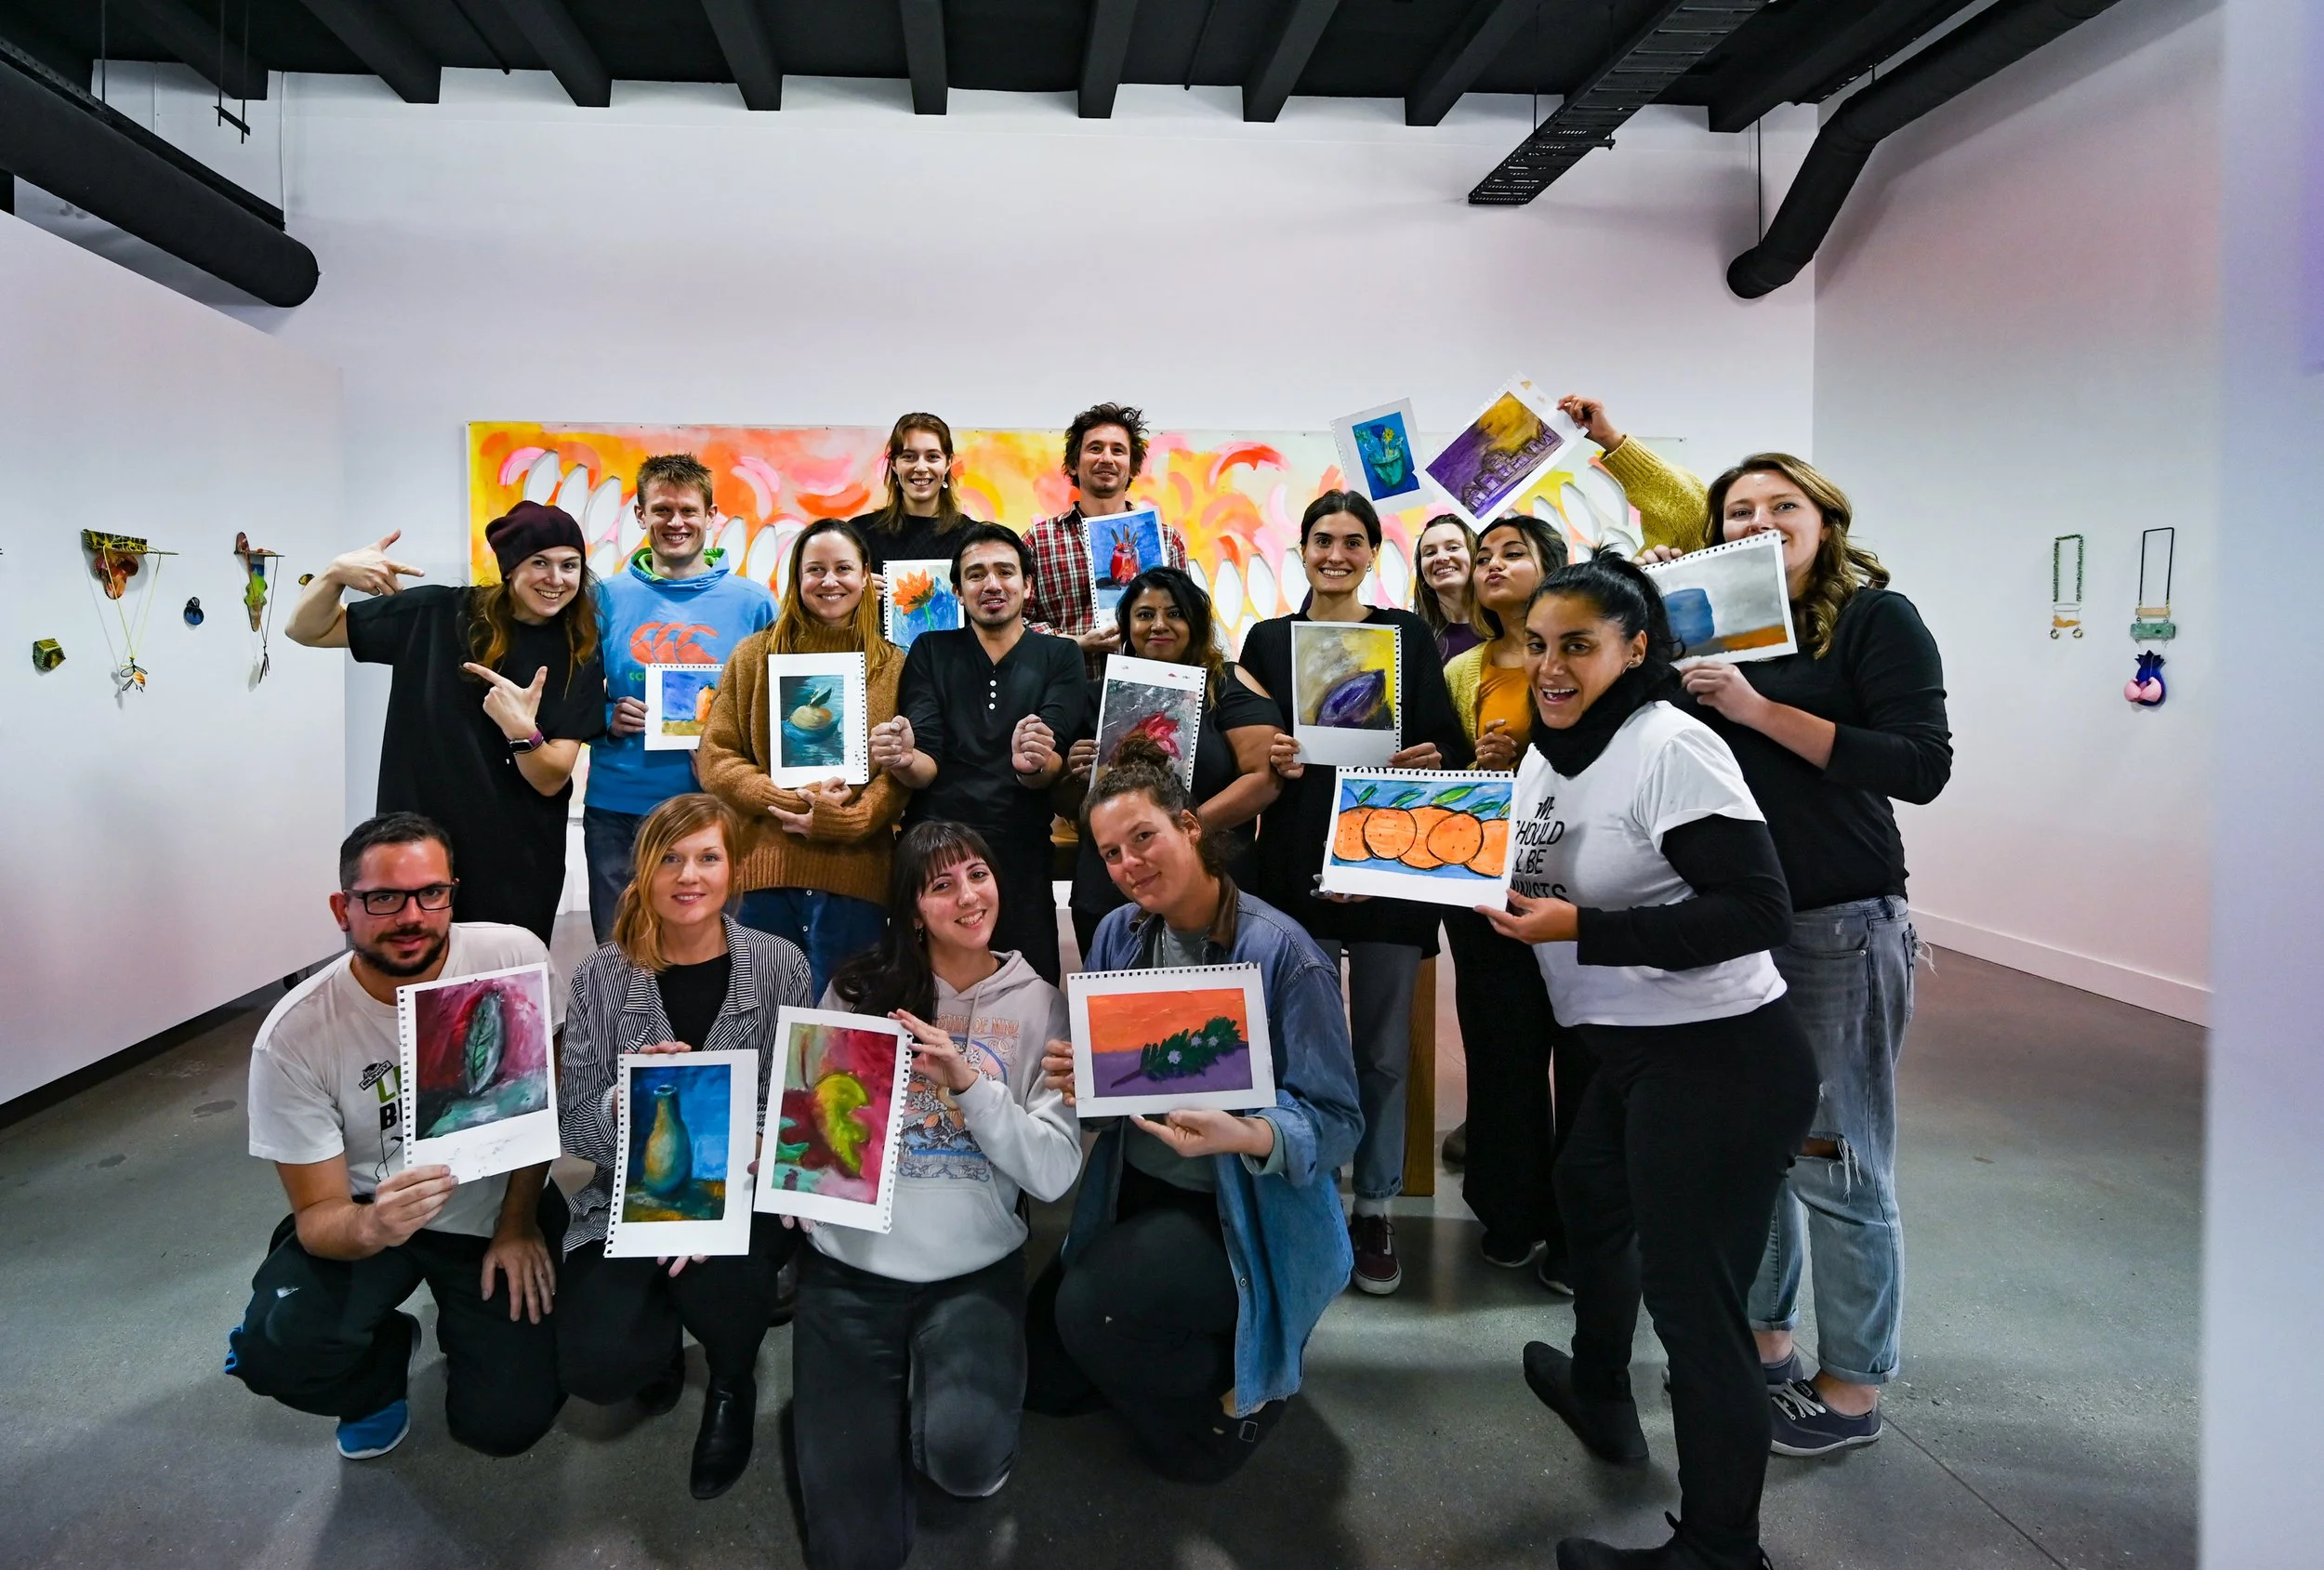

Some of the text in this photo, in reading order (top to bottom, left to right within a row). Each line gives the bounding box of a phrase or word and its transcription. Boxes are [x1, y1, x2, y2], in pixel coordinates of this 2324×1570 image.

[1535, 797, 1554, 820] WE
[1515, 821, 1565, 846] HOULD
[1525, 850, 1547, 874] BE
[973, 1016, 988, 1034] OF
[992, 1018, 1020, 1036] MIND
